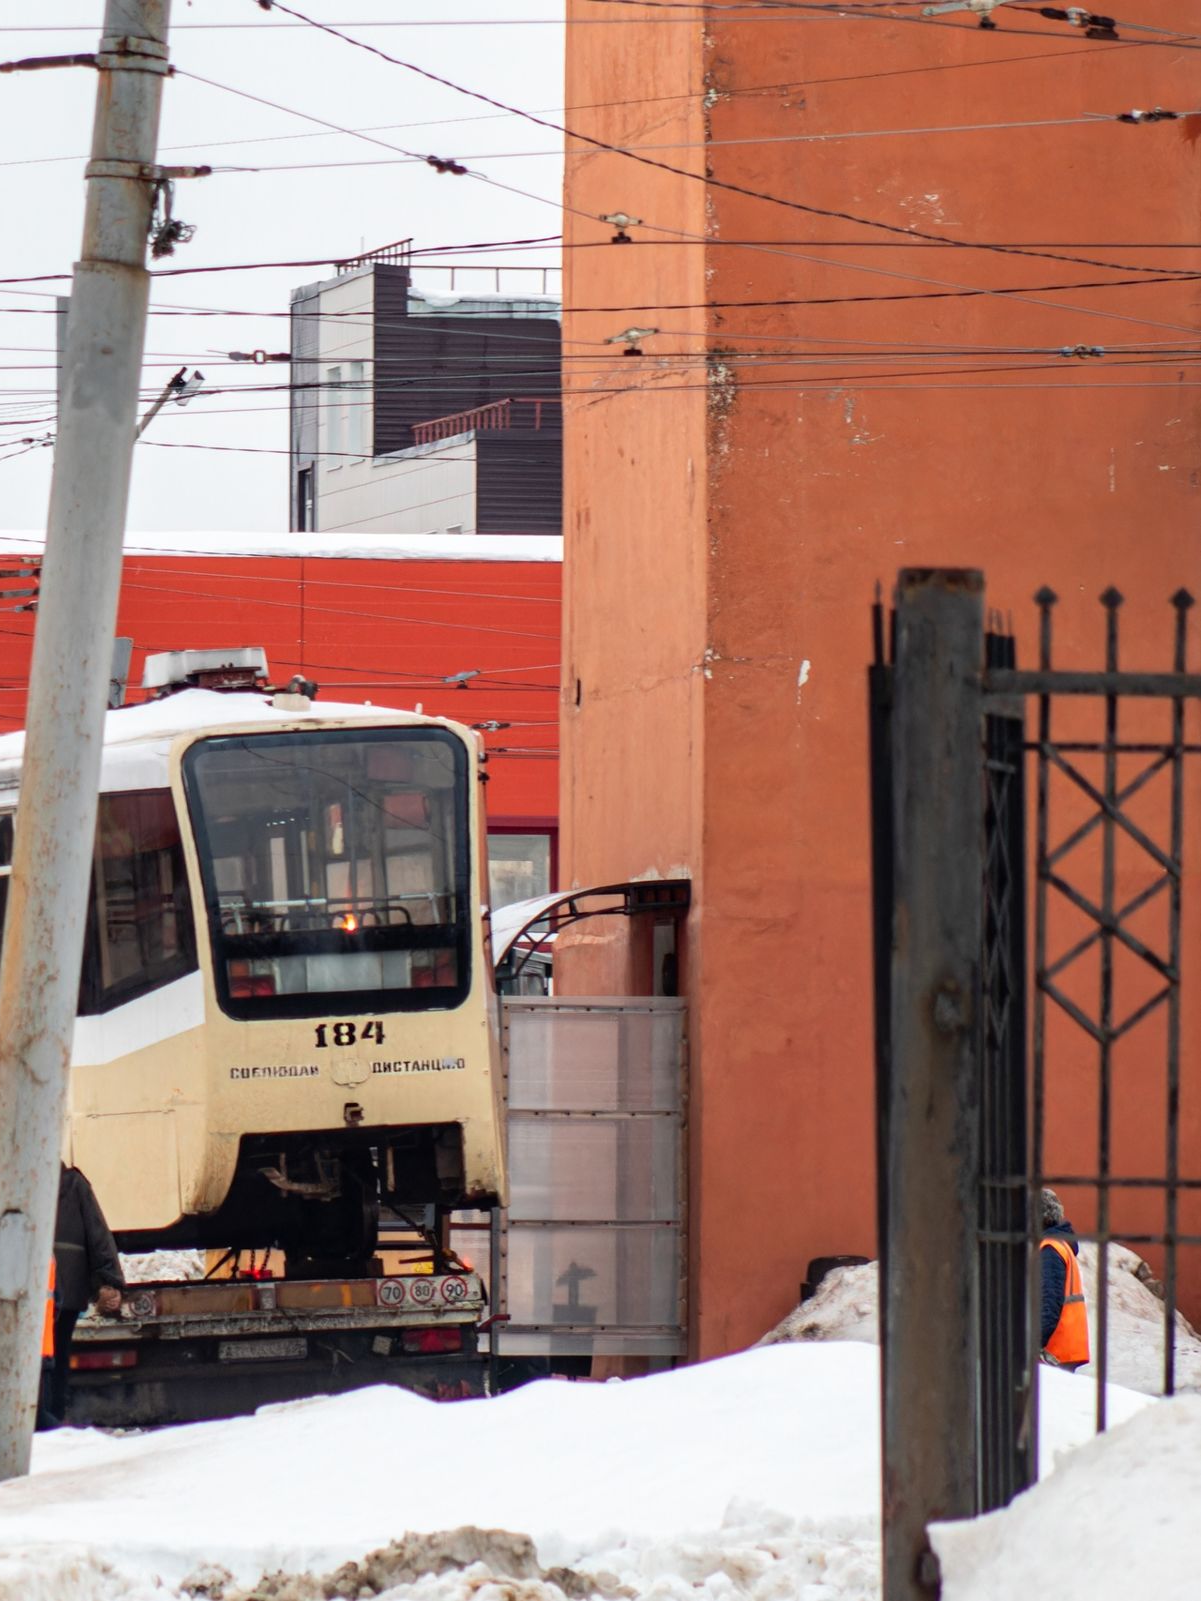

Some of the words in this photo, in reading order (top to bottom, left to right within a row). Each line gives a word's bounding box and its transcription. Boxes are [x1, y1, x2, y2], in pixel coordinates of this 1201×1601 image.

[315, 1021, 386, 1048] 184
[383, 1286, 401, 1300] 70
[414, 1285, 430, 1297] 80
[445, 1284, 463, 1297] 90
